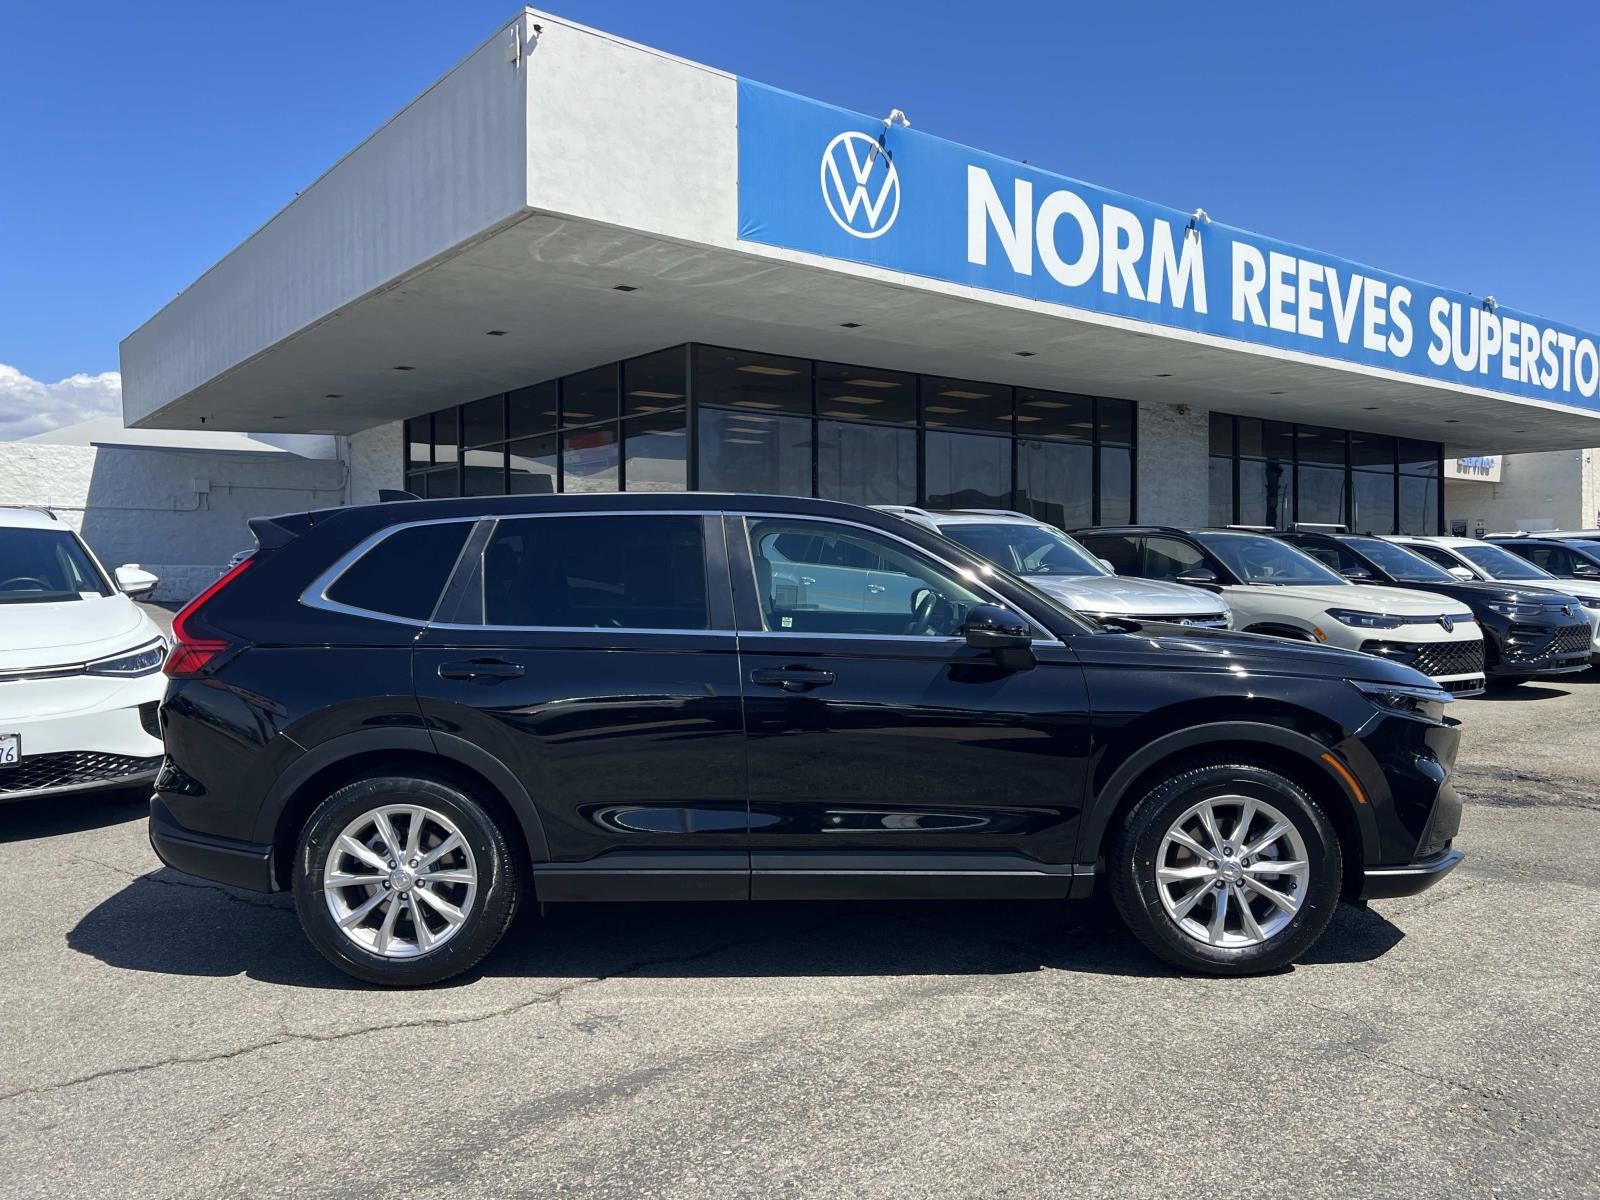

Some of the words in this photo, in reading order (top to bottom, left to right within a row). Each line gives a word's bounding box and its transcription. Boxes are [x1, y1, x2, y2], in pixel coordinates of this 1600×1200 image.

[967, 164, 1208, 314] NORM
[1232, 240, 1413, 358] REEVES
[1427, 296, 1600, 398] SUPERSTO
